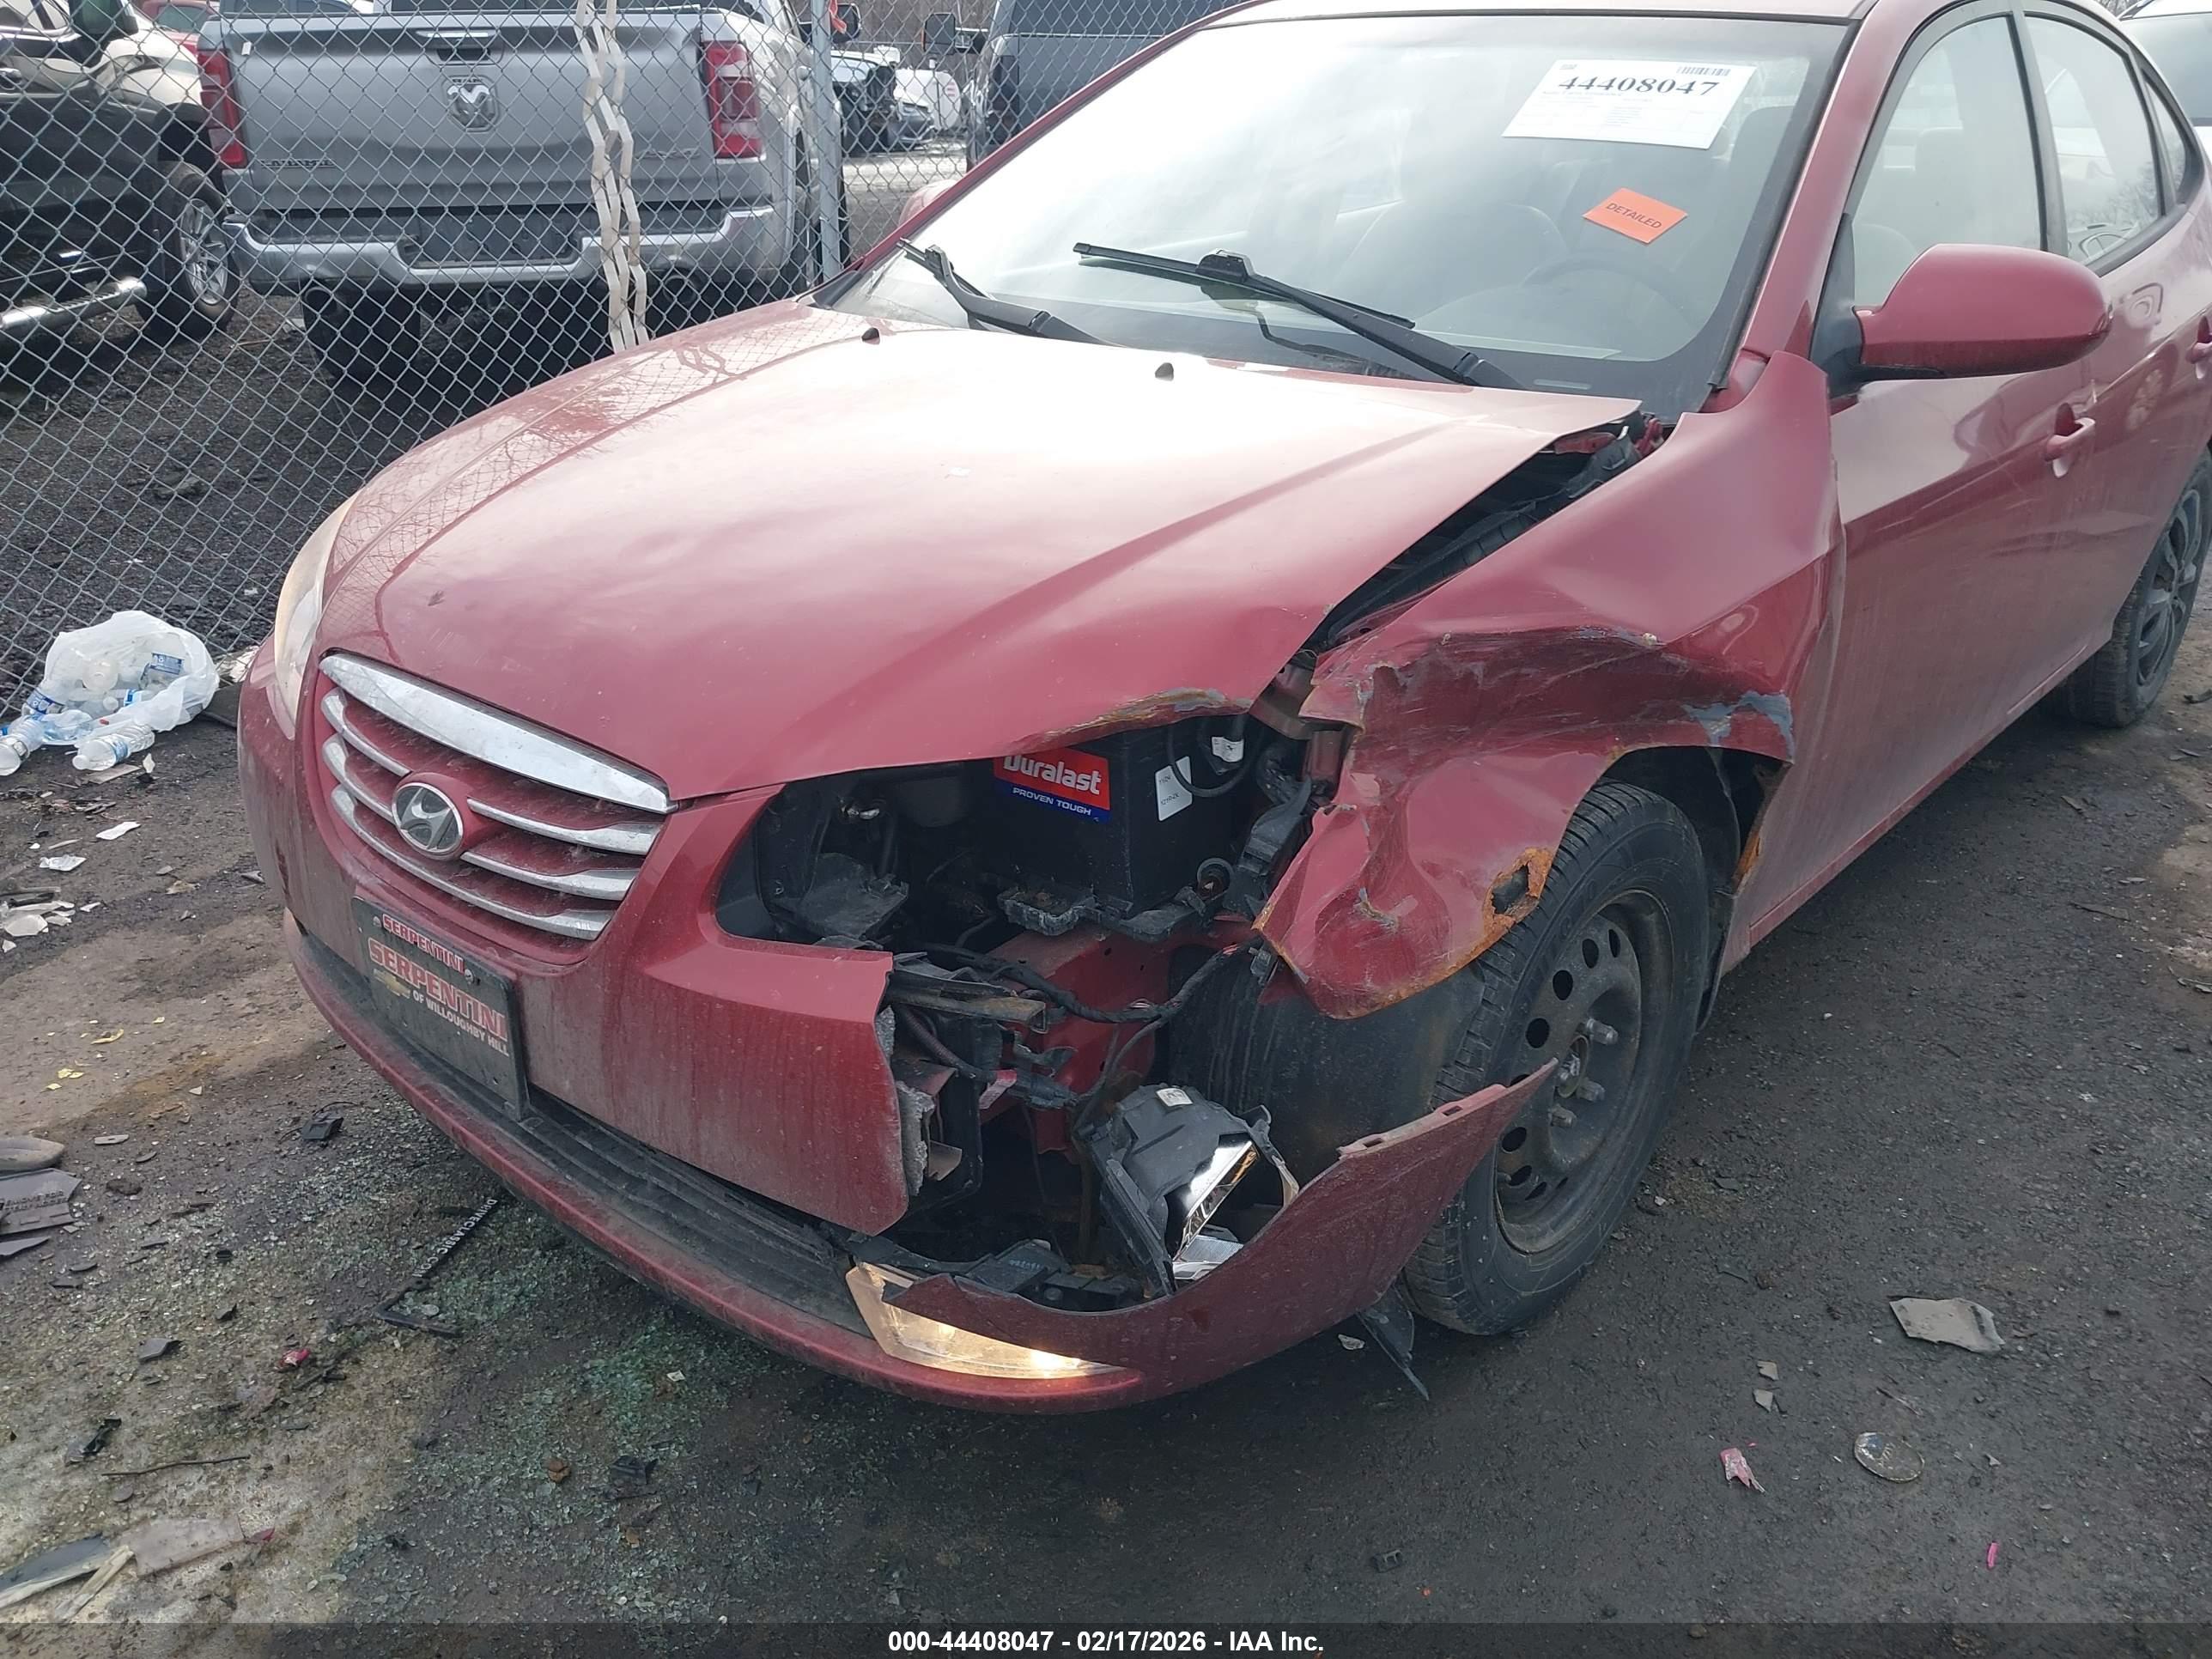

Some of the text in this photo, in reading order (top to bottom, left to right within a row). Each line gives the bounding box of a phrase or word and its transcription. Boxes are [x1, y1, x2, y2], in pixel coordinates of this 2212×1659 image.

[1559, 76, 1720, 96] 44408047
[1606, 202, 1662, 228] DETAILED
[1012, 787, 1091, 816] PROVEN TOUGH
[383, 914, 465, 975] SERPENTINI
[368, 937, 508, 1042] SERPENTINI
[412, 990, 425, 1004] OF
[426, 997, 486, 1042] WILLOUGHBY
